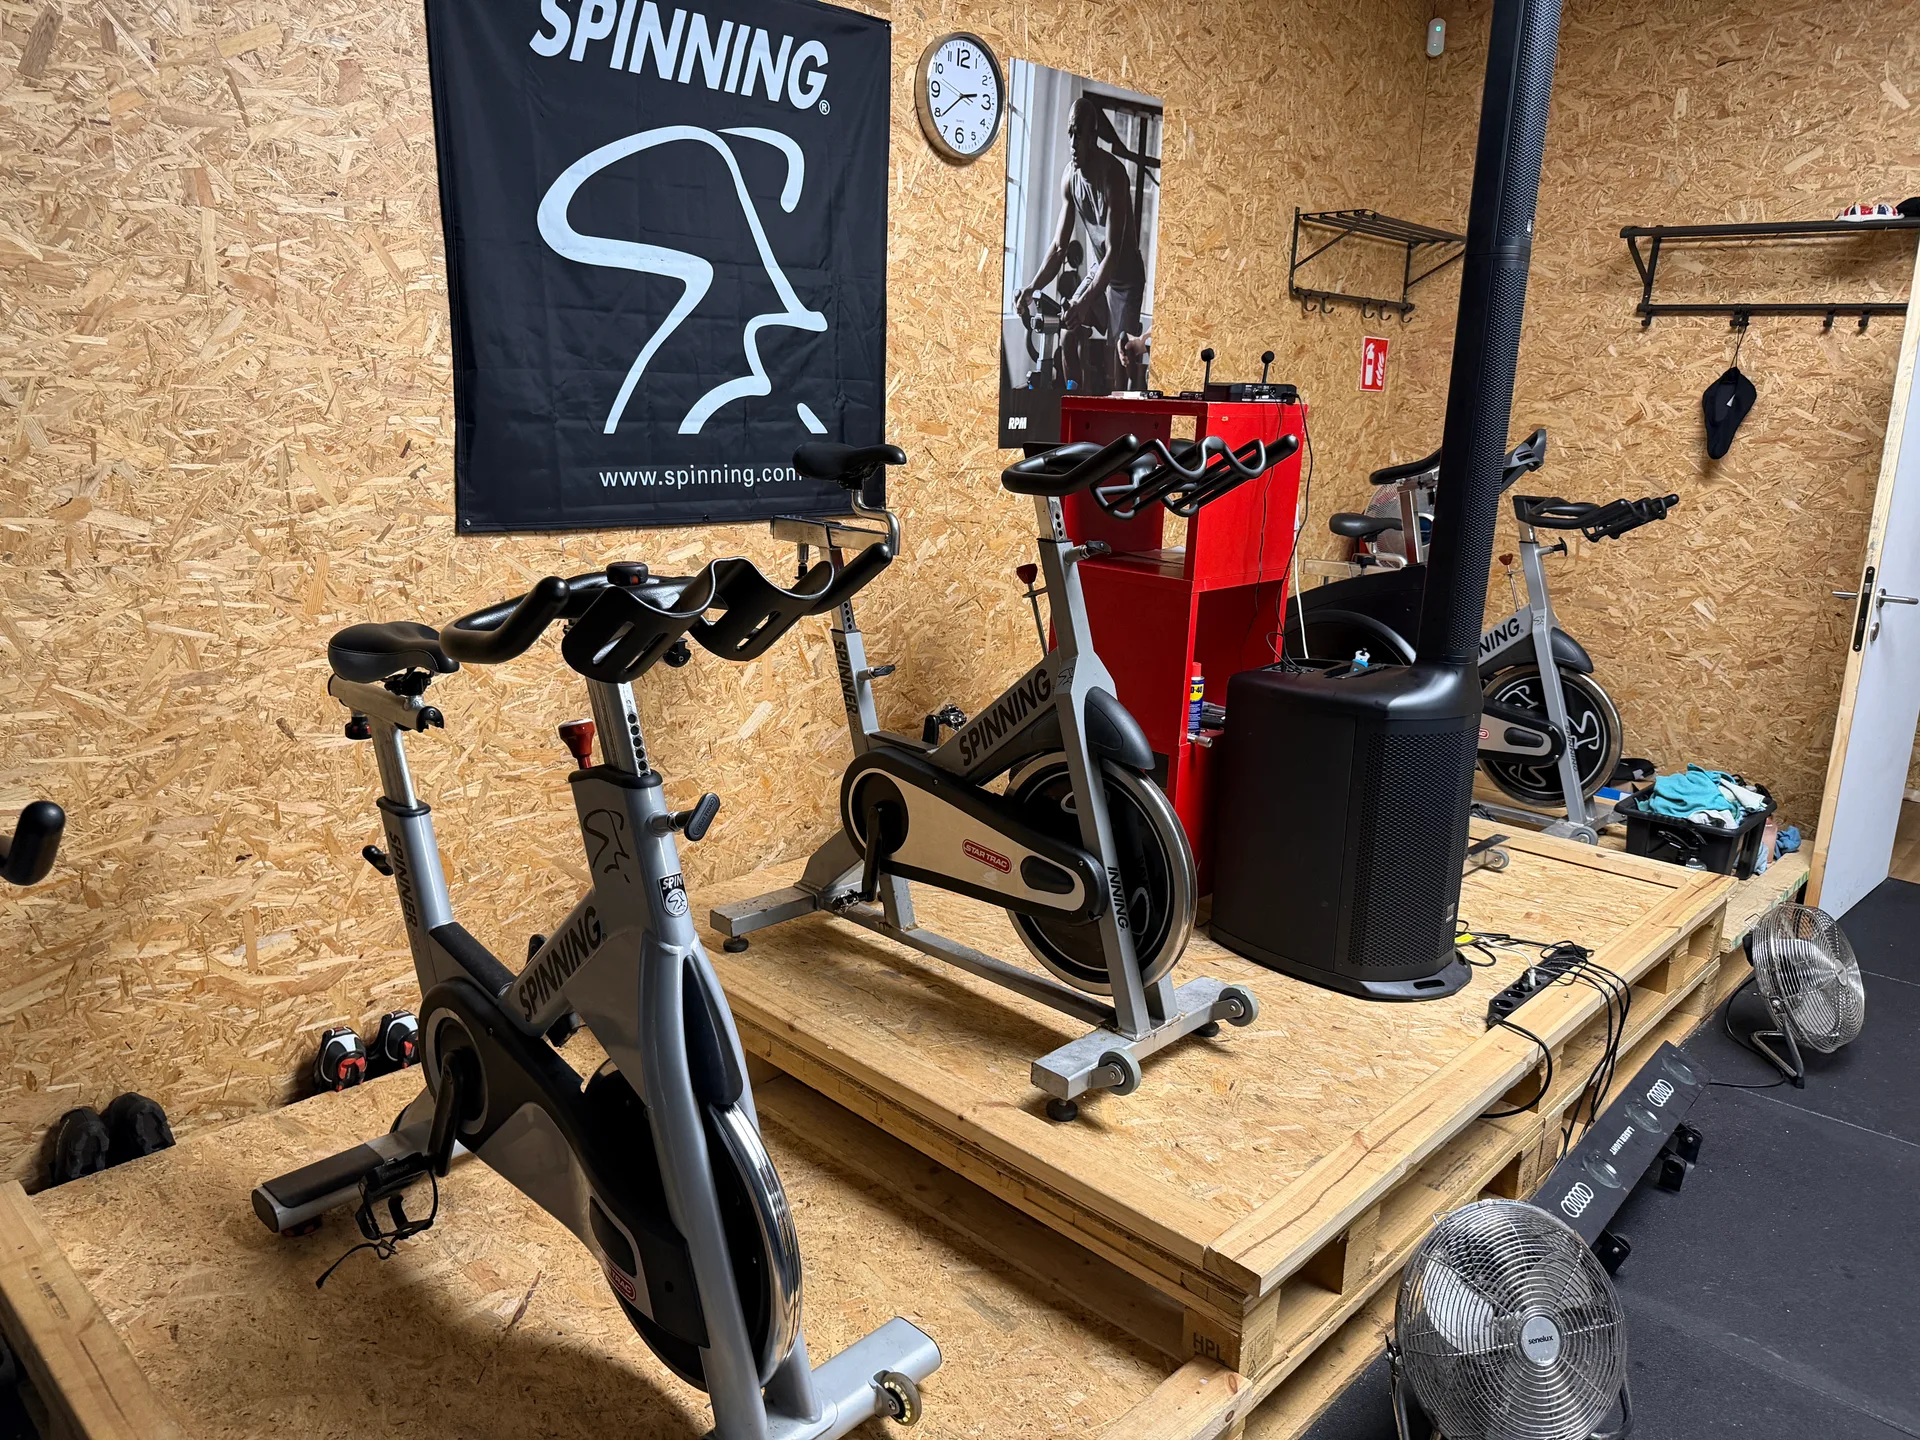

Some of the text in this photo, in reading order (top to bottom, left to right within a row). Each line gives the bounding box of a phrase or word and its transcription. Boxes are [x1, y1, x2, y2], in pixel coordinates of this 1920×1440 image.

[947, 50, 953, 62] 11
[957, 48, 971, 69] 12
[974, 58, 978, 69] 1
[933, 62, 944, 74] 10
[981, 75, 988, 86] 2
[931, 80, 940, 98] 9
[981, 94, 991, 110] 3
[934, 107, 941, 118] 8
[943, 125, 948, 135] 7
[980, 118, 986, 127] 4
[954, 127, 964, 144] 6
[971, 131, 976, 141] 5
[1008, 416, 1027, 430] RPM
[834, 640, 858, 715] SPINNER
[958, 668, 1051, 767] SPINNING
[966, 844, 1007, 868] STAR TRAC
[389, 831, 418, 928] SPINNER
[519, 905, 602, 1023] SPINNING
